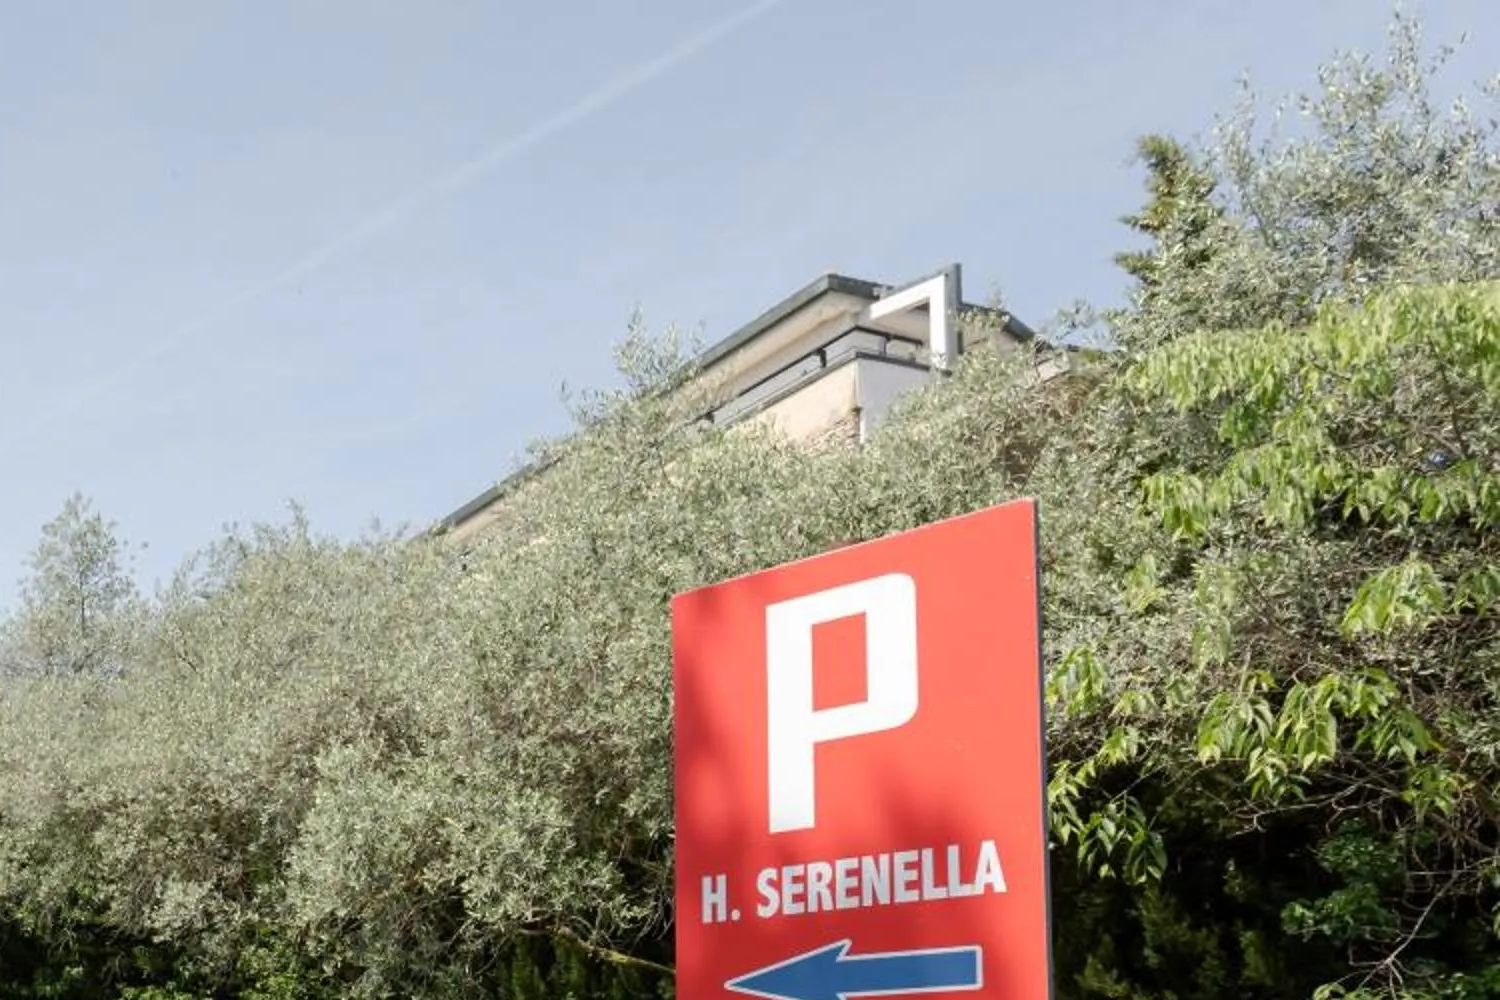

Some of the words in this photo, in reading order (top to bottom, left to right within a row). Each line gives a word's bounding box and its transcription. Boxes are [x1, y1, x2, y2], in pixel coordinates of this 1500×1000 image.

[765, 572, 919, 833] P
[701, 874, 740, 924] H.
[756, 840, 1008, 919] SERENELLA
